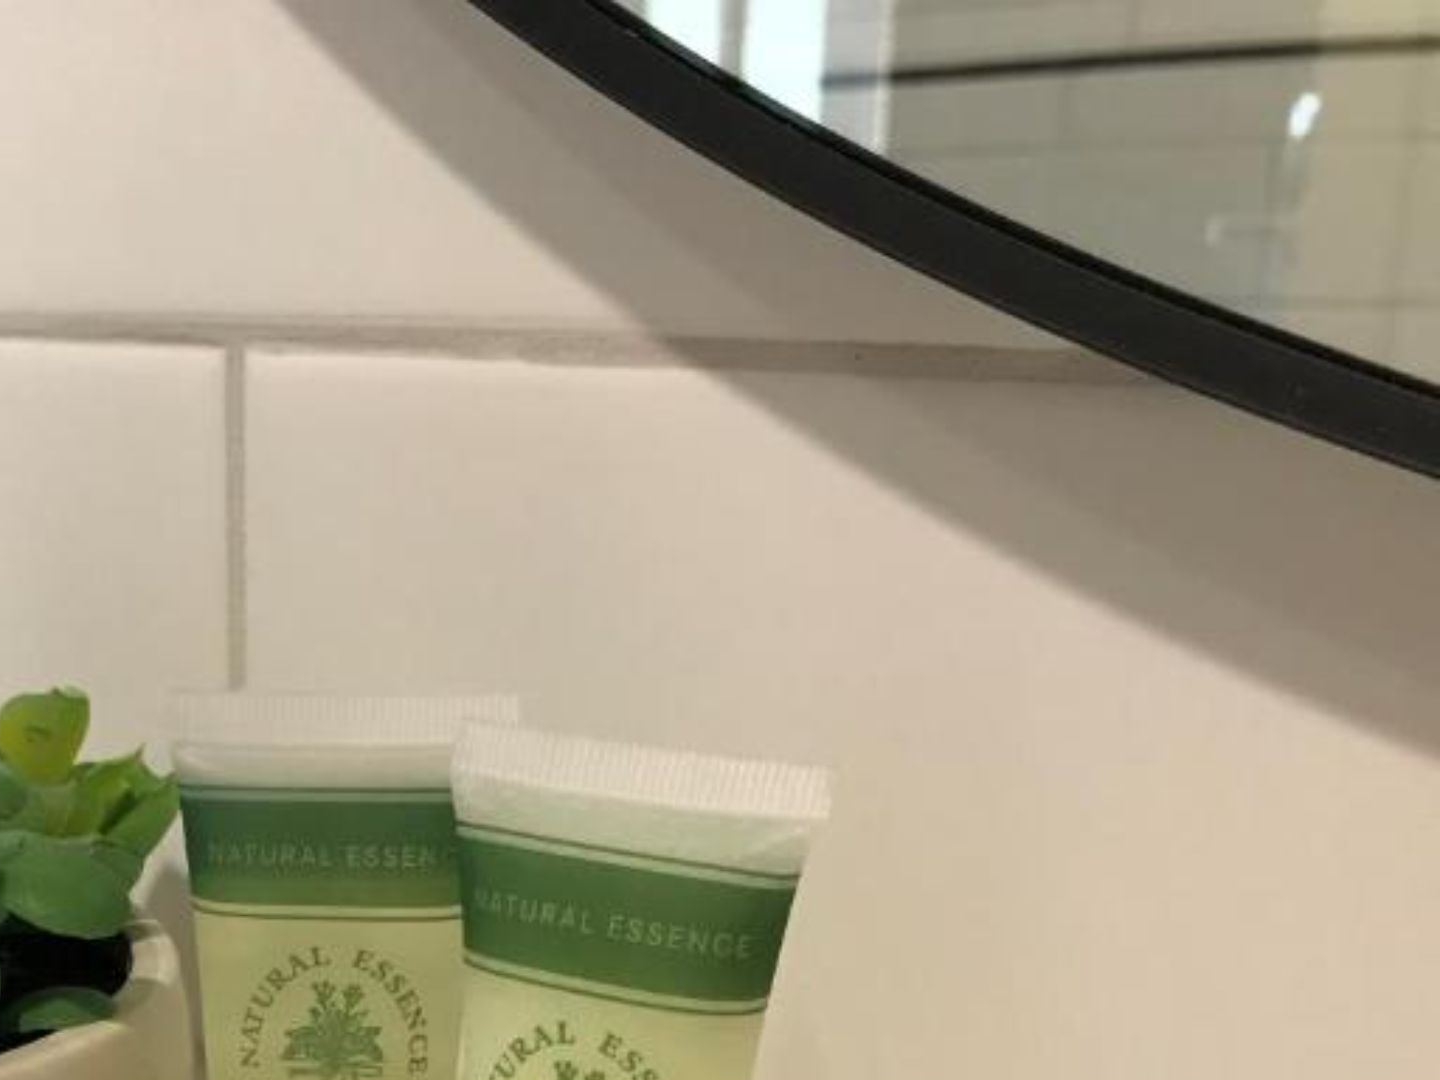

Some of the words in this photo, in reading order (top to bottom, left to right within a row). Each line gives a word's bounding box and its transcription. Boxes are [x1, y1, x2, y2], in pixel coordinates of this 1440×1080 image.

[207, 841, 333, 868] NATURAL
[346, 845, 439, 870] ESSEN
[474, 887, 596, 935] NATURAL
[607, 914, 754, 959] ESSENCE
[240, 946, 331, 1069] NATURAL
[352, 948, 429, 1077] ESSENCE
